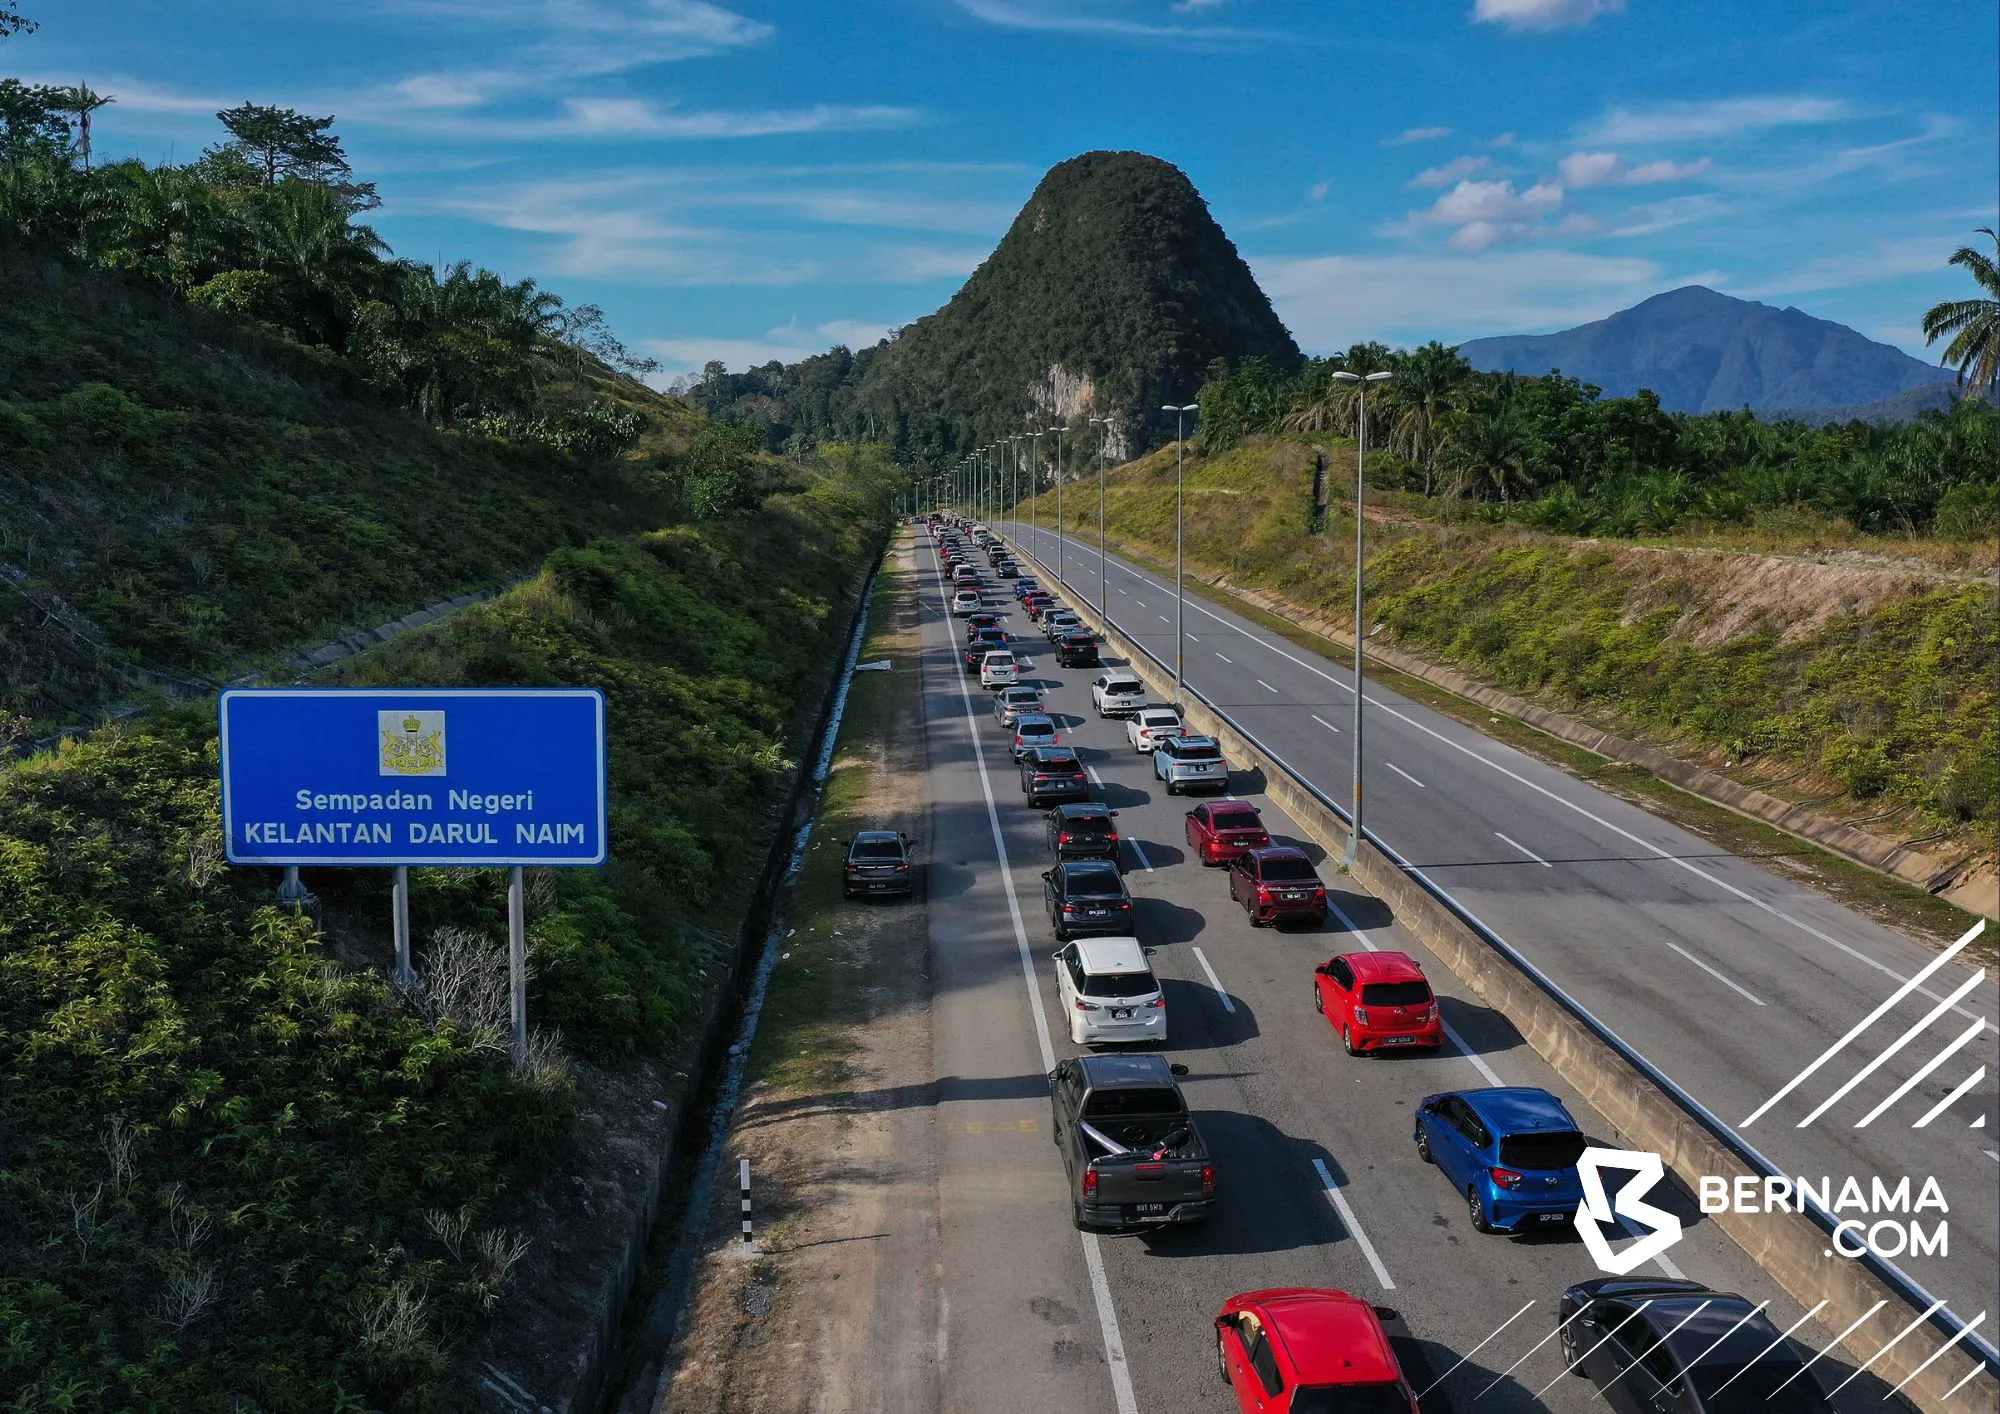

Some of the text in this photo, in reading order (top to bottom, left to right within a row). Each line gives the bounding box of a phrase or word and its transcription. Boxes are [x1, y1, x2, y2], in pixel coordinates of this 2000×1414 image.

[296, 790, 532, 814] Sempadan Negeri
[246, 823, 583, 843] KELANTAN DARUL NAIM
